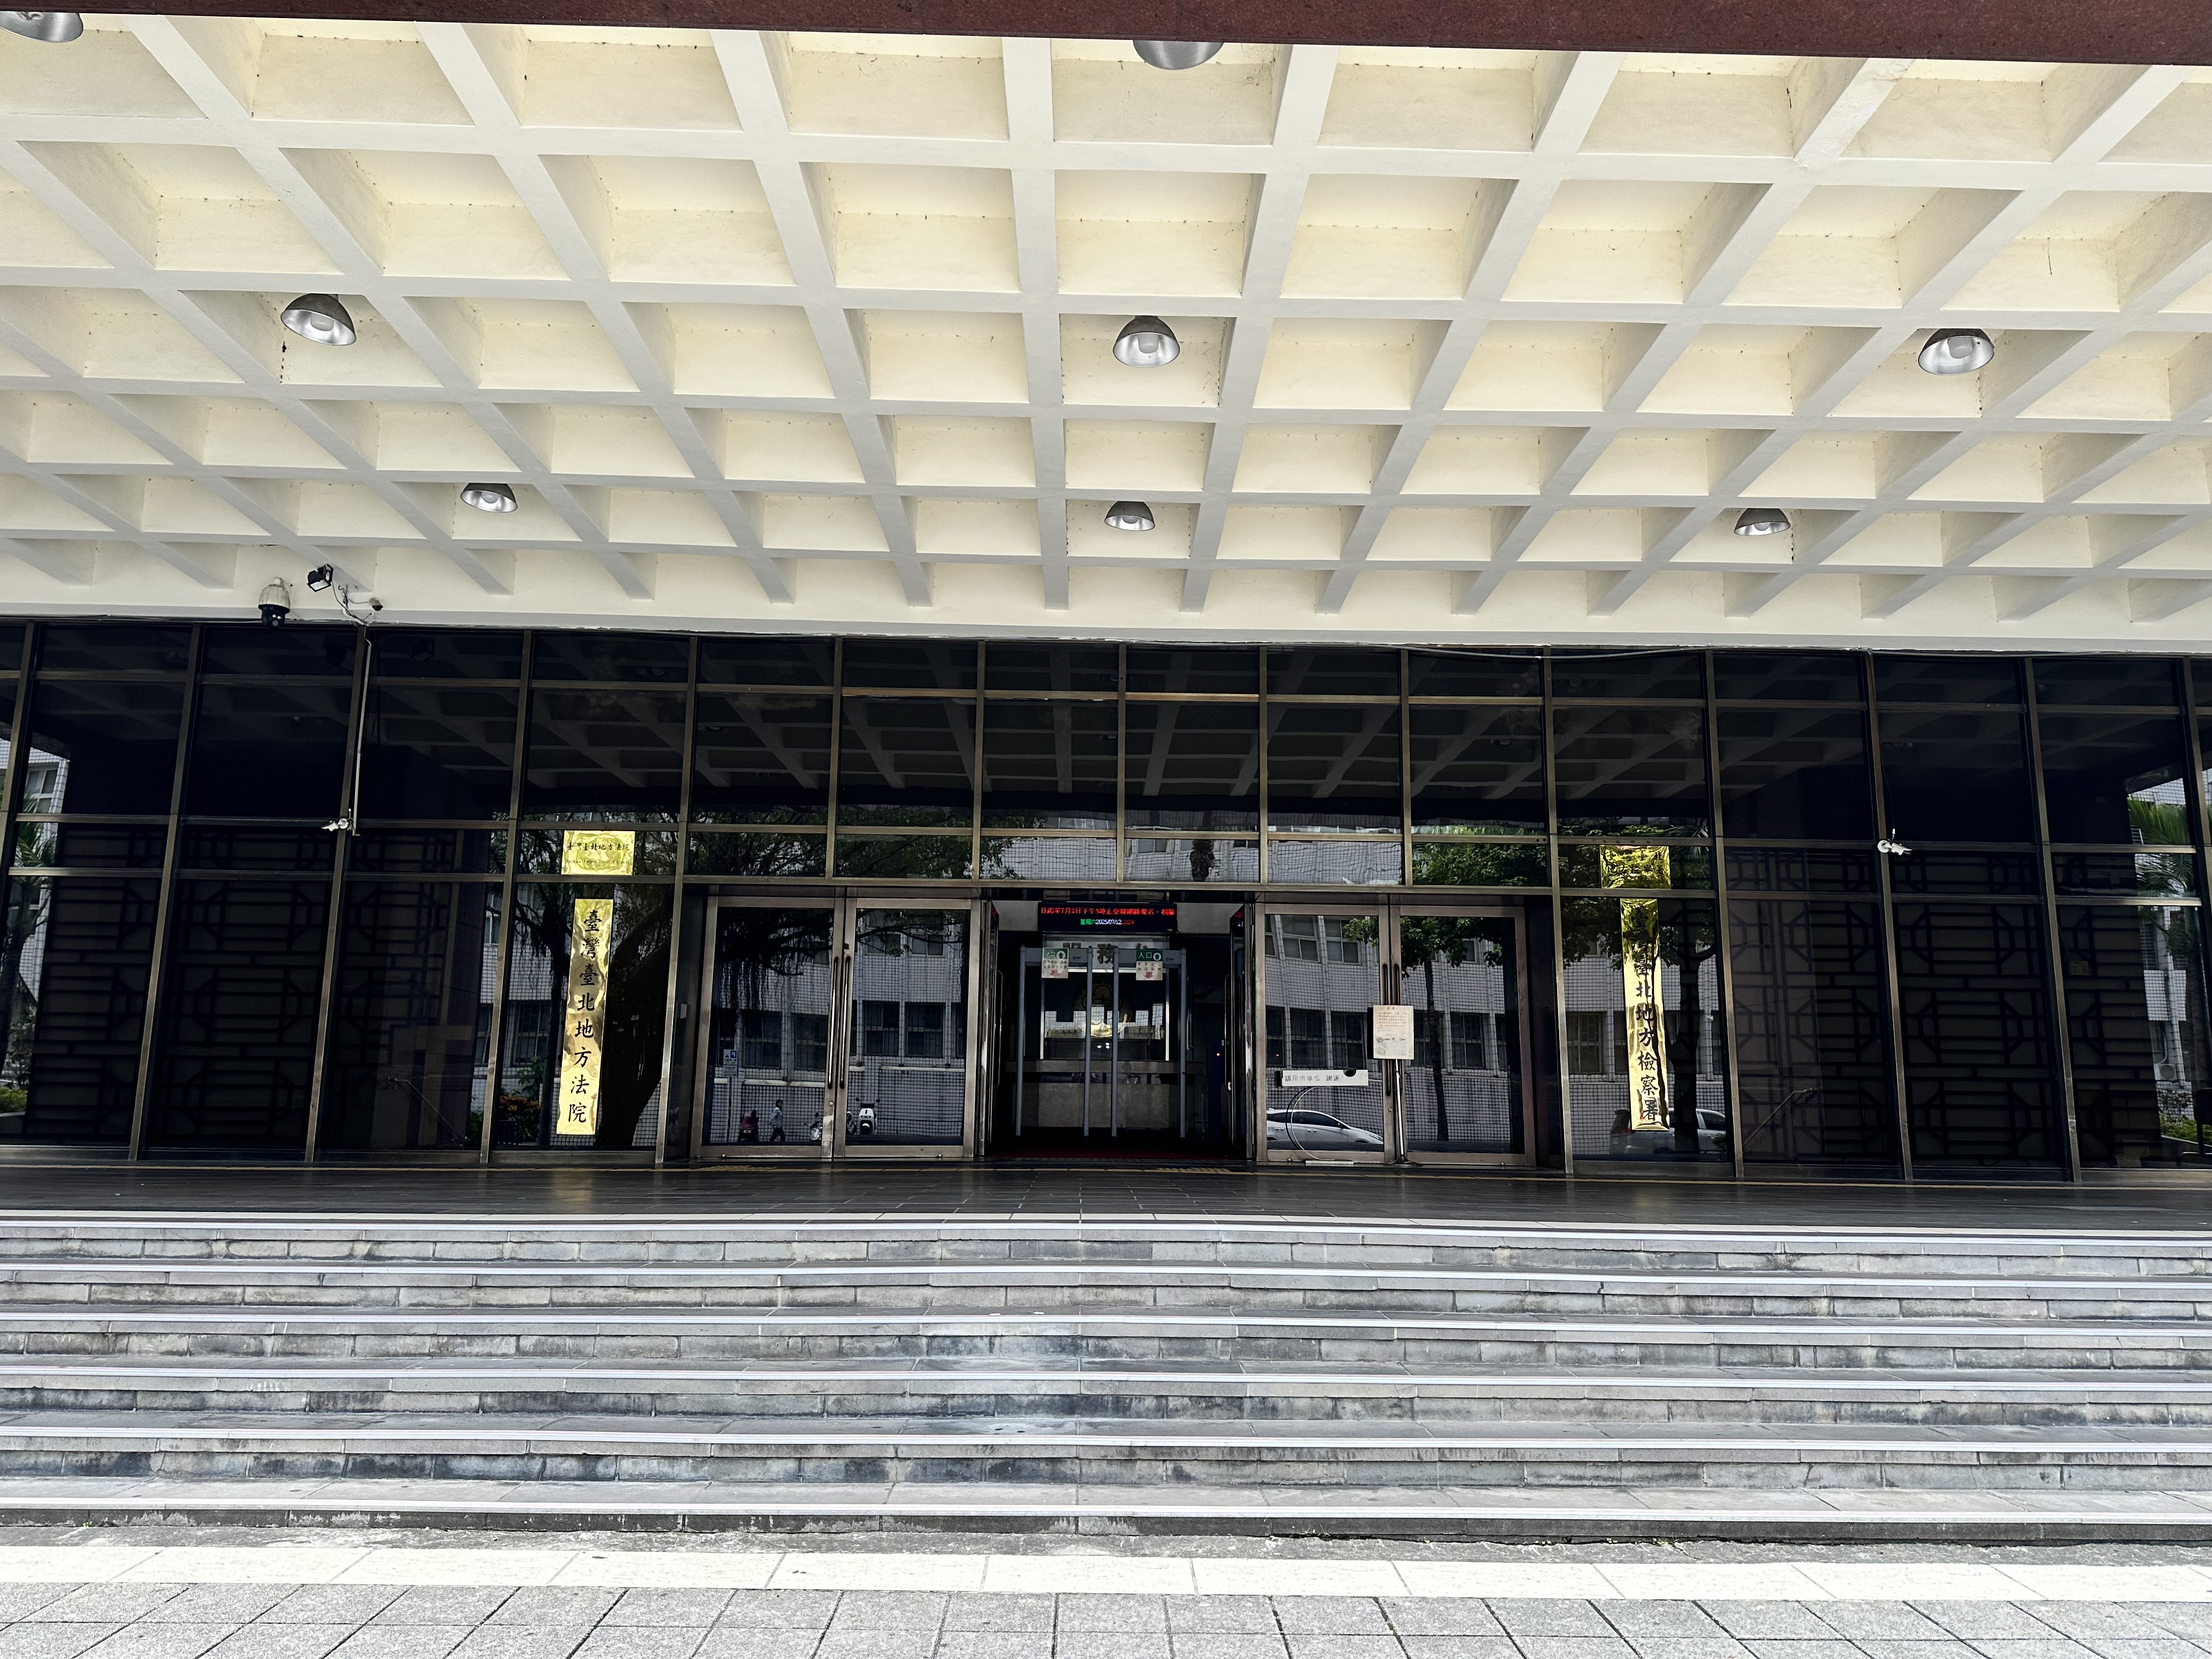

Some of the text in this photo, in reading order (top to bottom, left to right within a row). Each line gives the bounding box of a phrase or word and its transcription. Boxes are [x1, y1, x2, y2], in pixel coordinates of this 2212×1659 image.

[568, 910, 602, 1123] 臺灣臺北地方法院
